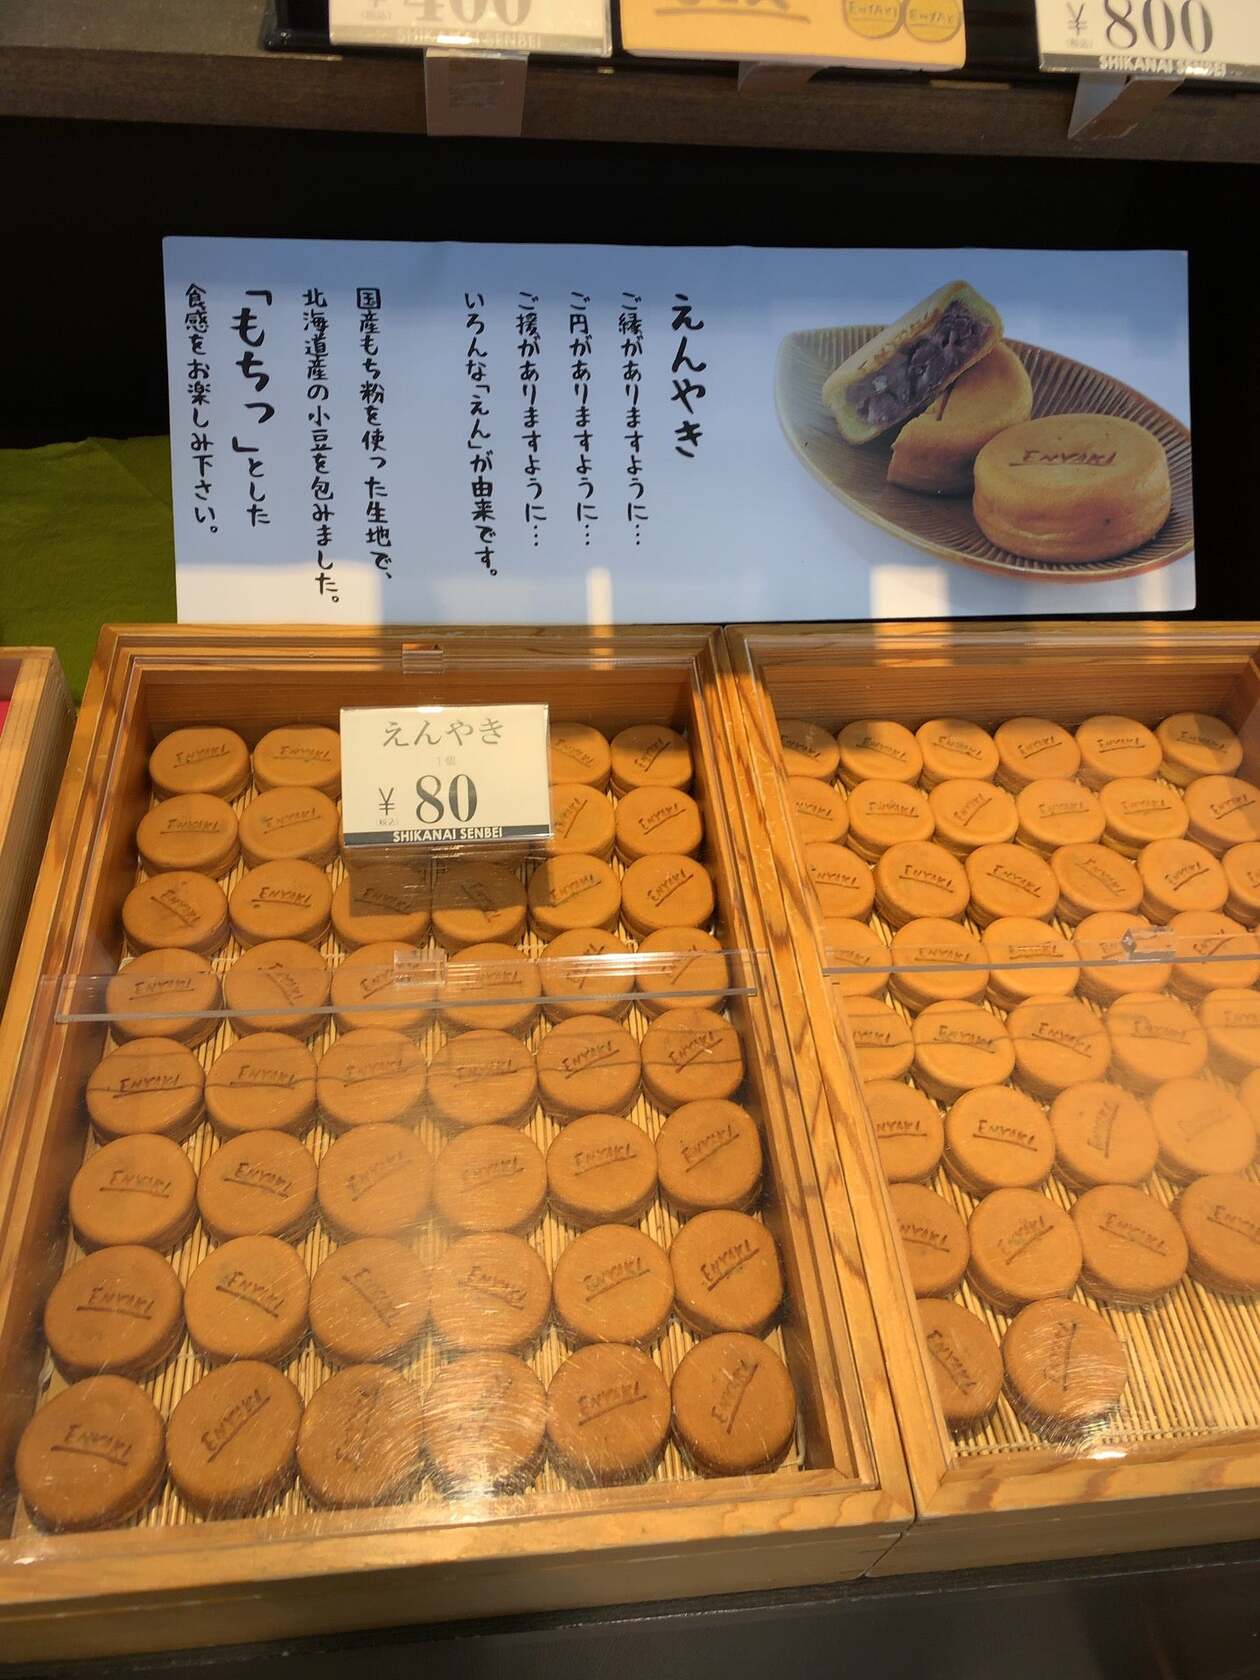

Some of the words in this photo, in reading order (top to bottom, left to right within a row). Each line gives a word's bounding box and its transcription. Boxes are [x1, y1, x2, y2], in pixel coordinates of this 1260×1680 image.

[1099, 55, 1172, 73] SHIKANAI
[1104, 0, 1213, 53] 800
[185, 283, 218, 534] 食感をお楽しみ下さい。
[671, 293, 707, 458] えんやき
[302, 288, 340, 603] 北海道産の小豆を包みました。
[356, 287, 392, 579] 国産もち粉を使った生地で、
[464, 292, 498, 576] いろんな「えん」が由来です。
[383, 718, 504, 747] えんやき
[393, 827, 456, 843] SHIKANAI
[460, 826, 503, 840] SENBEI
[416, 773, 478, 825] 80
